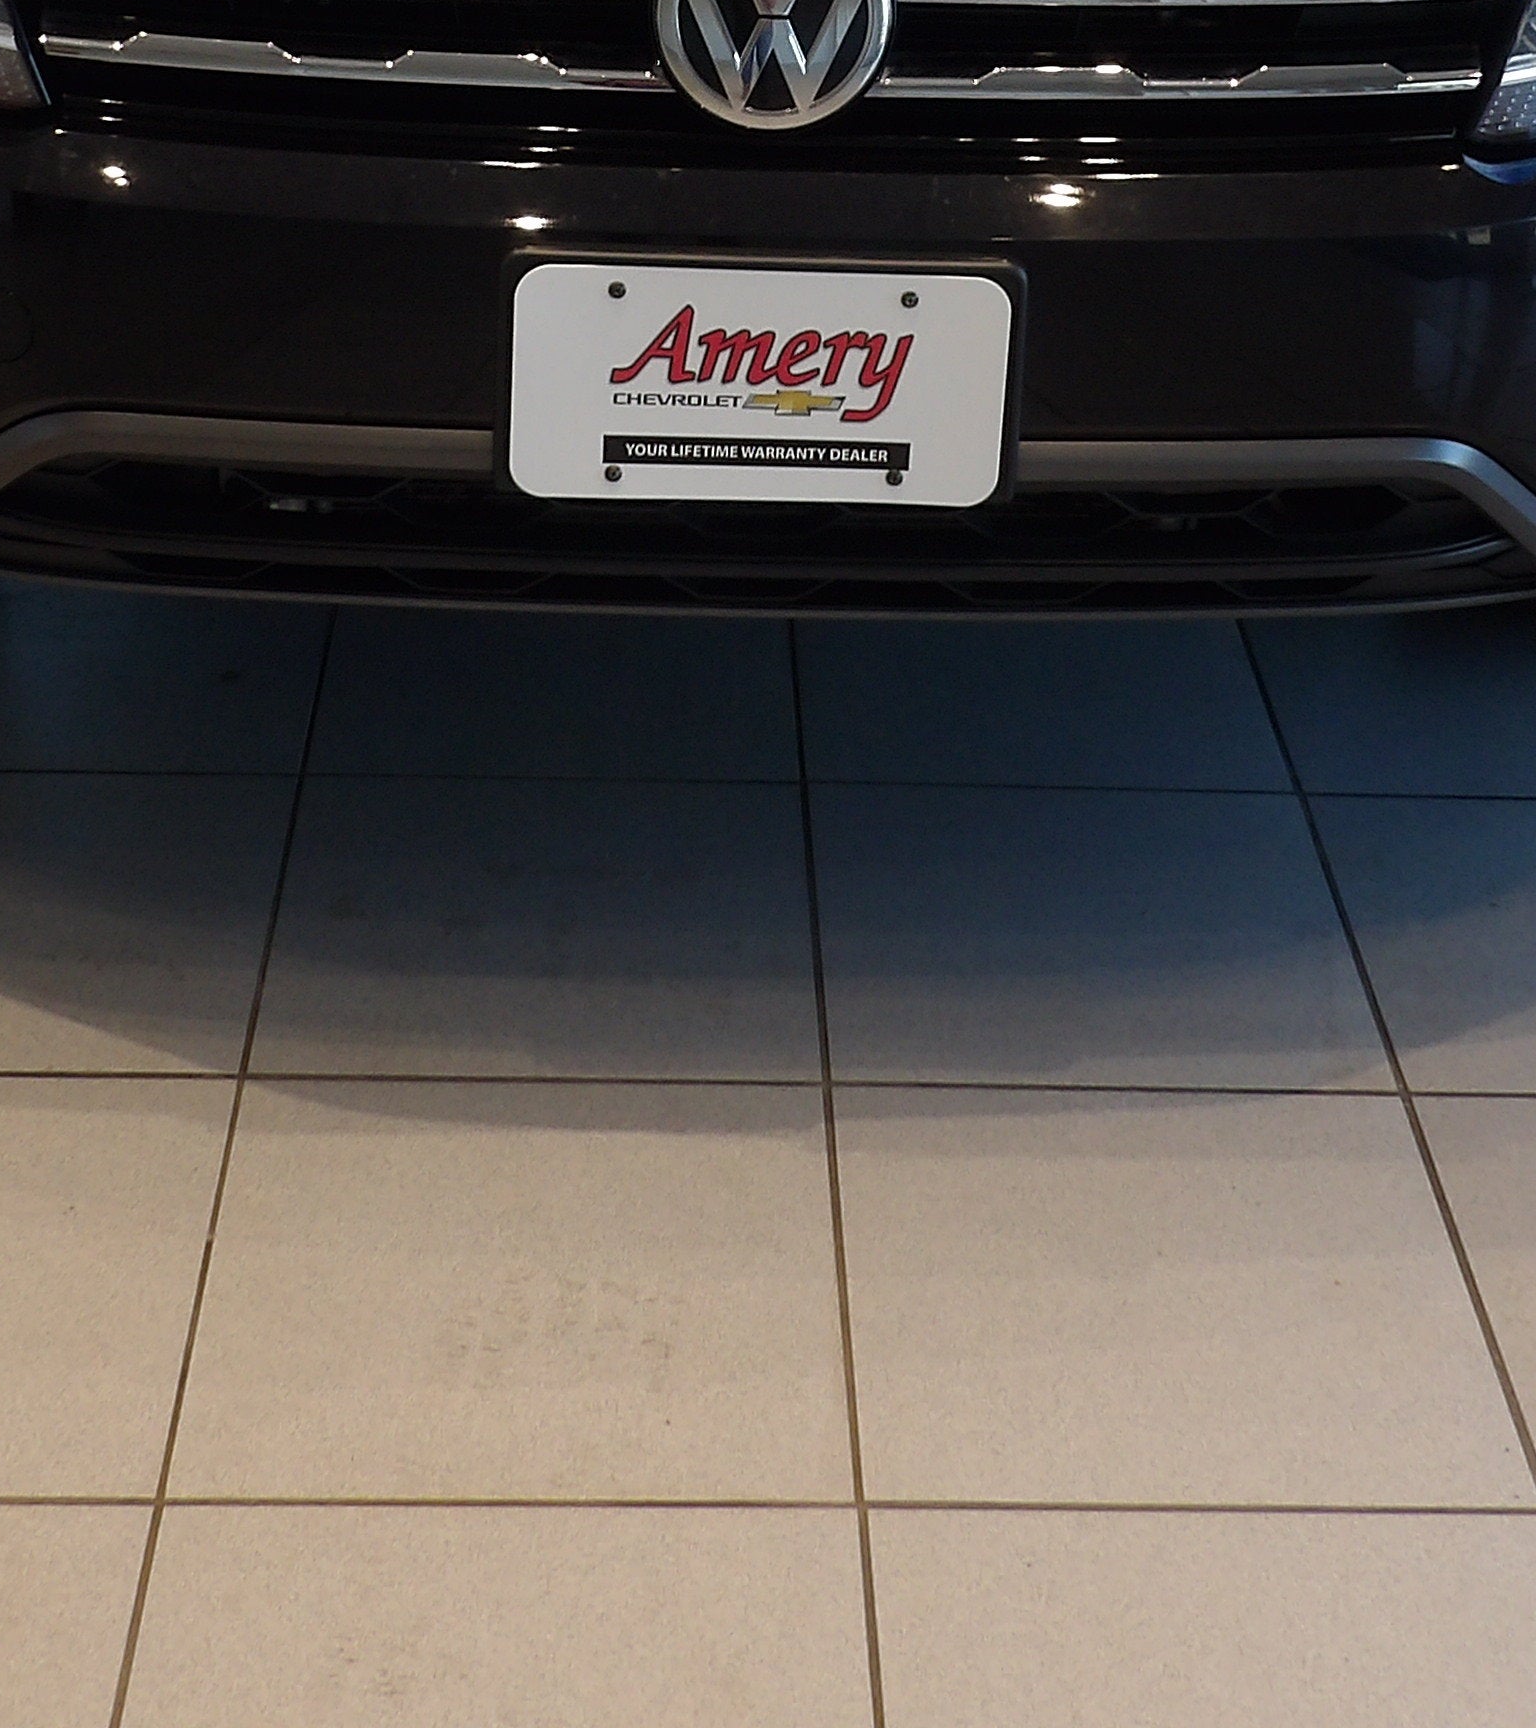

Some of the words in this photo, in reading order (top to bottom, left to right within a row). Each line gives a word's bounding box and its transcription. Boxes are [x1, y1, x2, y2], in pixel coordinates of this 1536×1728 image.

[610, 303, 915, 423] Amery
[612, 392, 743, 408] CHEVROLET
[625, 442, 667, 458] YOUR
[670, 443, 739, 459] LIFETIME
[741, 445, 826, 462] WARRANTY
[829, 447, 889, 463] DEALER
